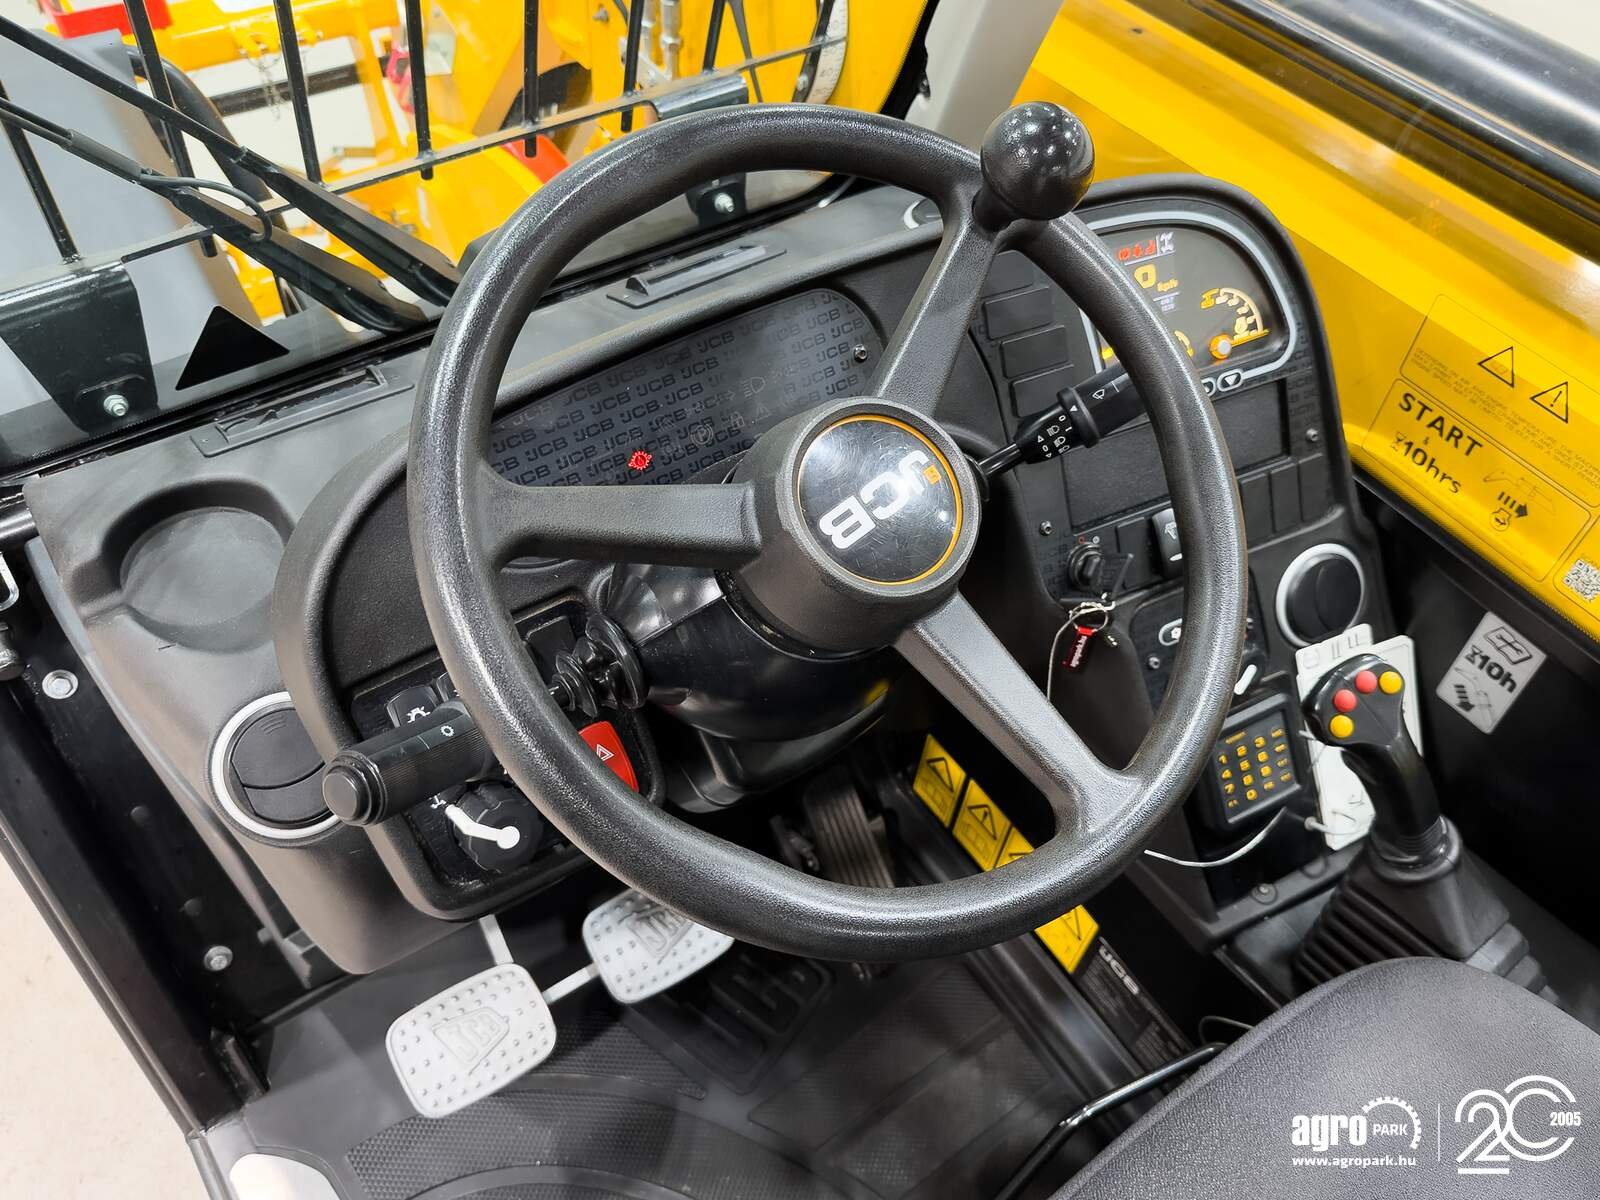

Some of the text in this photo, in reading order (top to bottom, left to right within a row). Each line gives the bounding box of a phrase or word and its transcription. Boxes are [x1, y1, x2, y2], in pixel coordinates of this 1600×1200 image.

[696, 330, 735, 351] JCB
[590, 392, 632, 415] JCB
[636, 374, 676, 397] JCB
[680, 356, 720, 379] JCB
[492, 428, 536, 453] JCB
[574, 418, 615, 442] JCB
[620, 400, 660, 423] JCB
[664, 382, 704, 405] JCB
[660, 443, 700, 466] JCB
[825, 375, 858, 395] JCB
[1398, 392, 1483, 457] START
[525, 437, 568, 461] JCB
[604, 427, 644, 450] JCB
[557, 445, 598, 470] JCB
[1401, 440, 1463, 495] 10hrs
[819, 450, 941, 549] JCB
[1477, 654, 1518, 694] 10h
[1219, 754, 1228, 765] 1
[1246, 788, 1258, 801] 0
[1099, 945, 1140, 995] JCB
